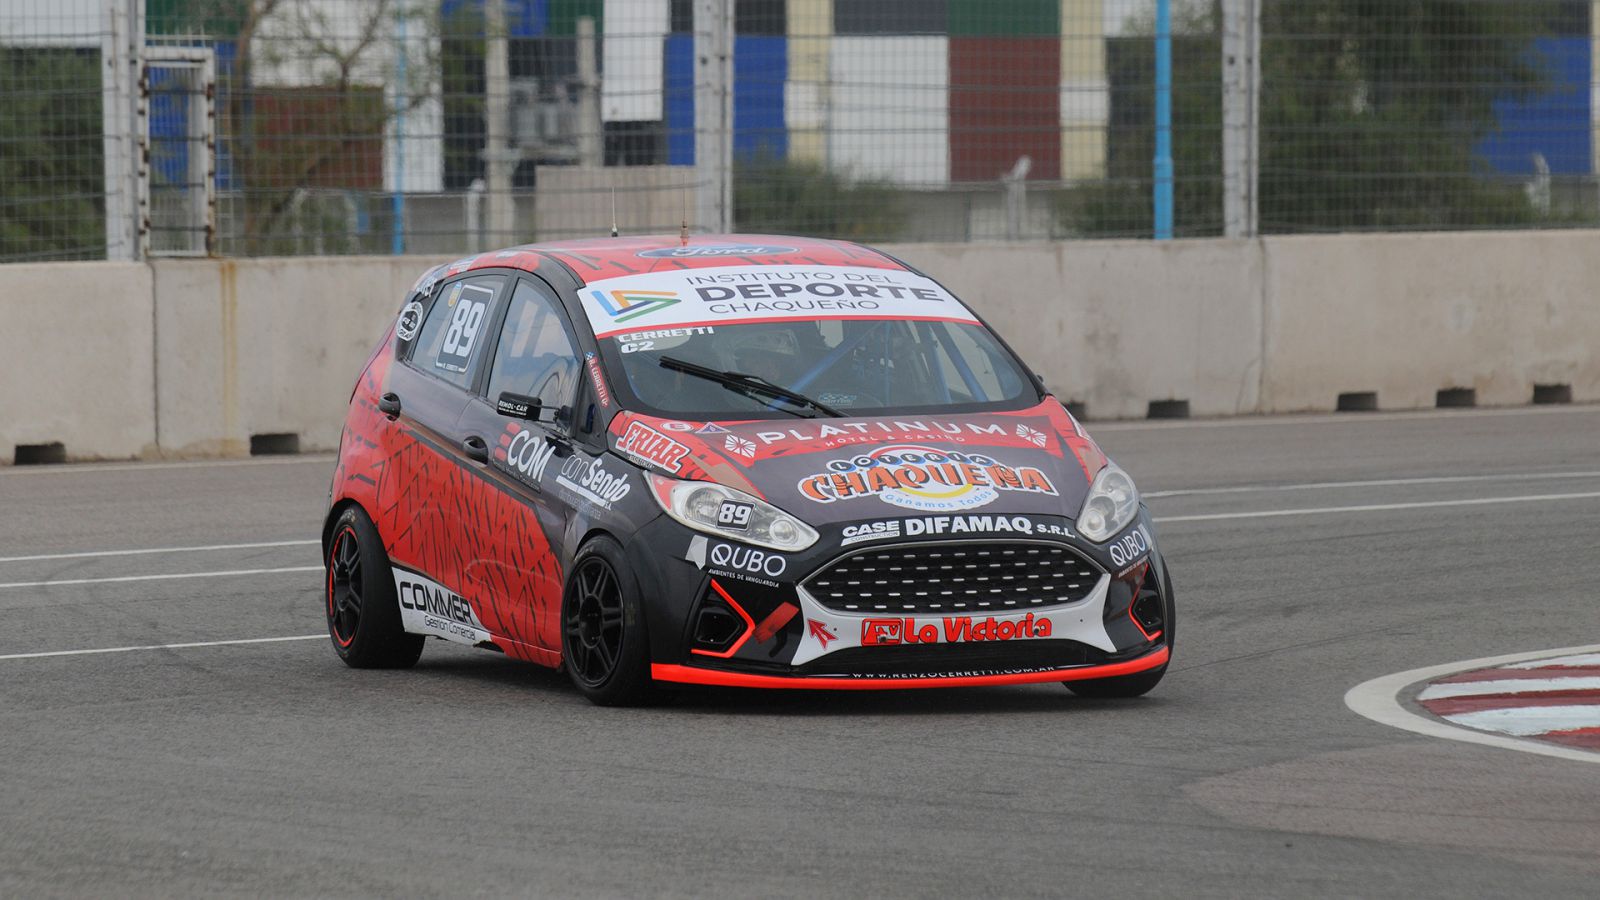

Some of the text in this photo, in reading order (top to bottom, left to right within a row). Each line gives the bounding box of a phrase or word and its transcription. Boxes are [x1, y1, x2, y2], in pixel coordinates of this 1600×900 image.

[671, 246, 768, 257] Ford
[686, 270, 903, 285] INSTITUTO DEL
[695, 282, 945, 302] DEPORTE
[709, 298, 880, 315] CHAQUEÑO
[443, 299, 486, 357] 89
[618, 327, 714, 343] CERRETTI
[620, 340, 655, 354] C2
[756, 421, 1008, 445] PLATINUM
[825, 435, 879, 447] HOTEL
[905, 434, 966, 443] CASINO
[616, 420, 691, 474] FRIAR
[885, 491, 993, 508] Ganamos Todos
[718, 503, 750, 525] 89
[842, 516, 1076, 539] CASE DIFAMAQ S.R.L.
[1109, 530, 1146, 567] QUBO
[711, 544, 787, 577] QUBO
[400, 581, 474, 625] COMMER
[904, 617, 938, 643] La
[942, 612, 1053, 643] Victoria
